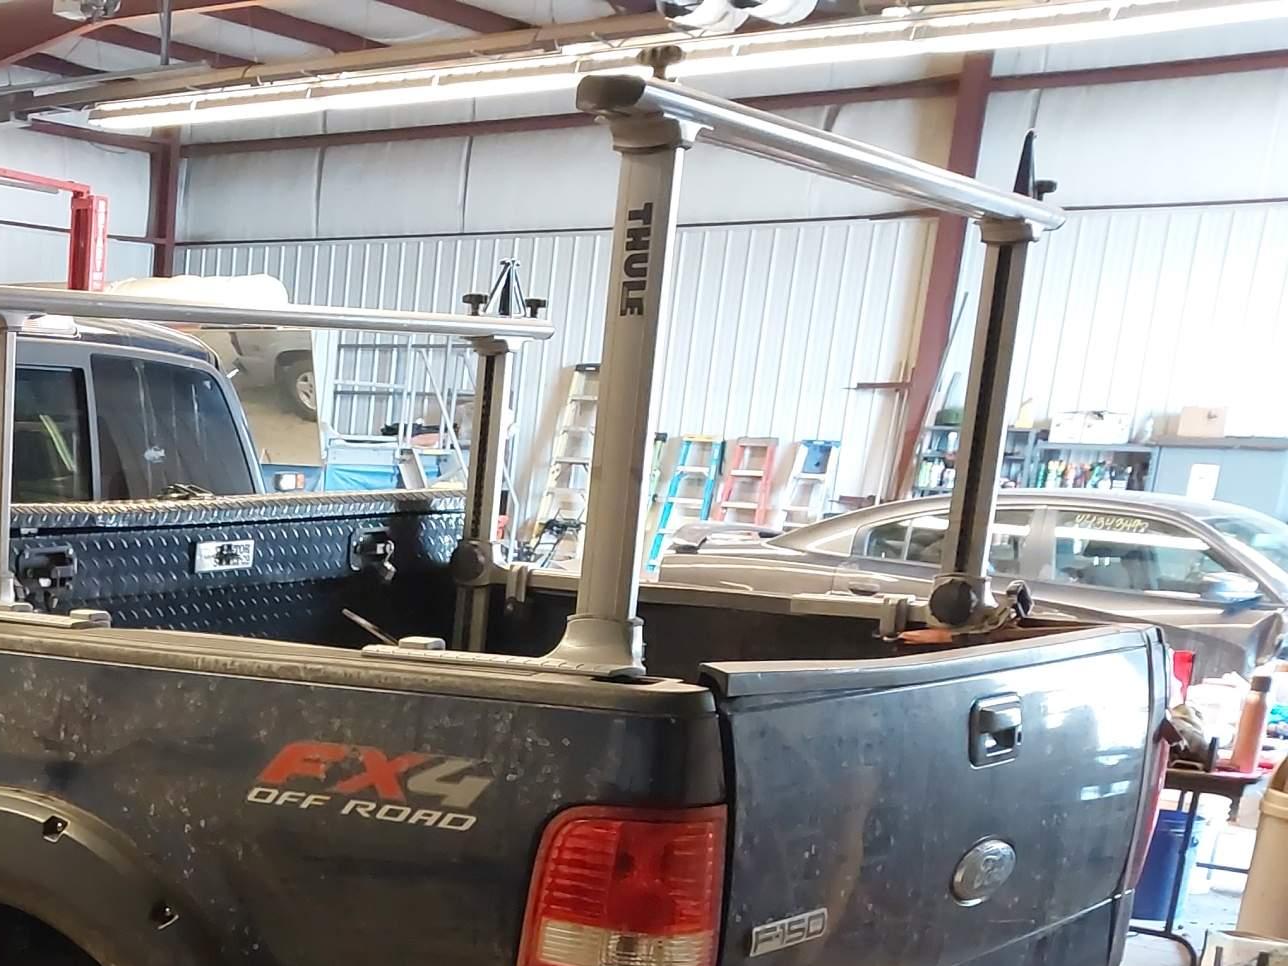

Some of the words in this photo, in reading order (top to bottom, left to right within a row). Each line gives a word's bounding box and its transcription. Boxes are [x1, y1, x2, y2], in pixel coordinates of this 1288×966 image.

[619, 202, 653, 317] THULE
[255, 741, 496, 809] FX4
[246, 787, 331, 809] OFF
[340, 799, 477, 832] ROAD
